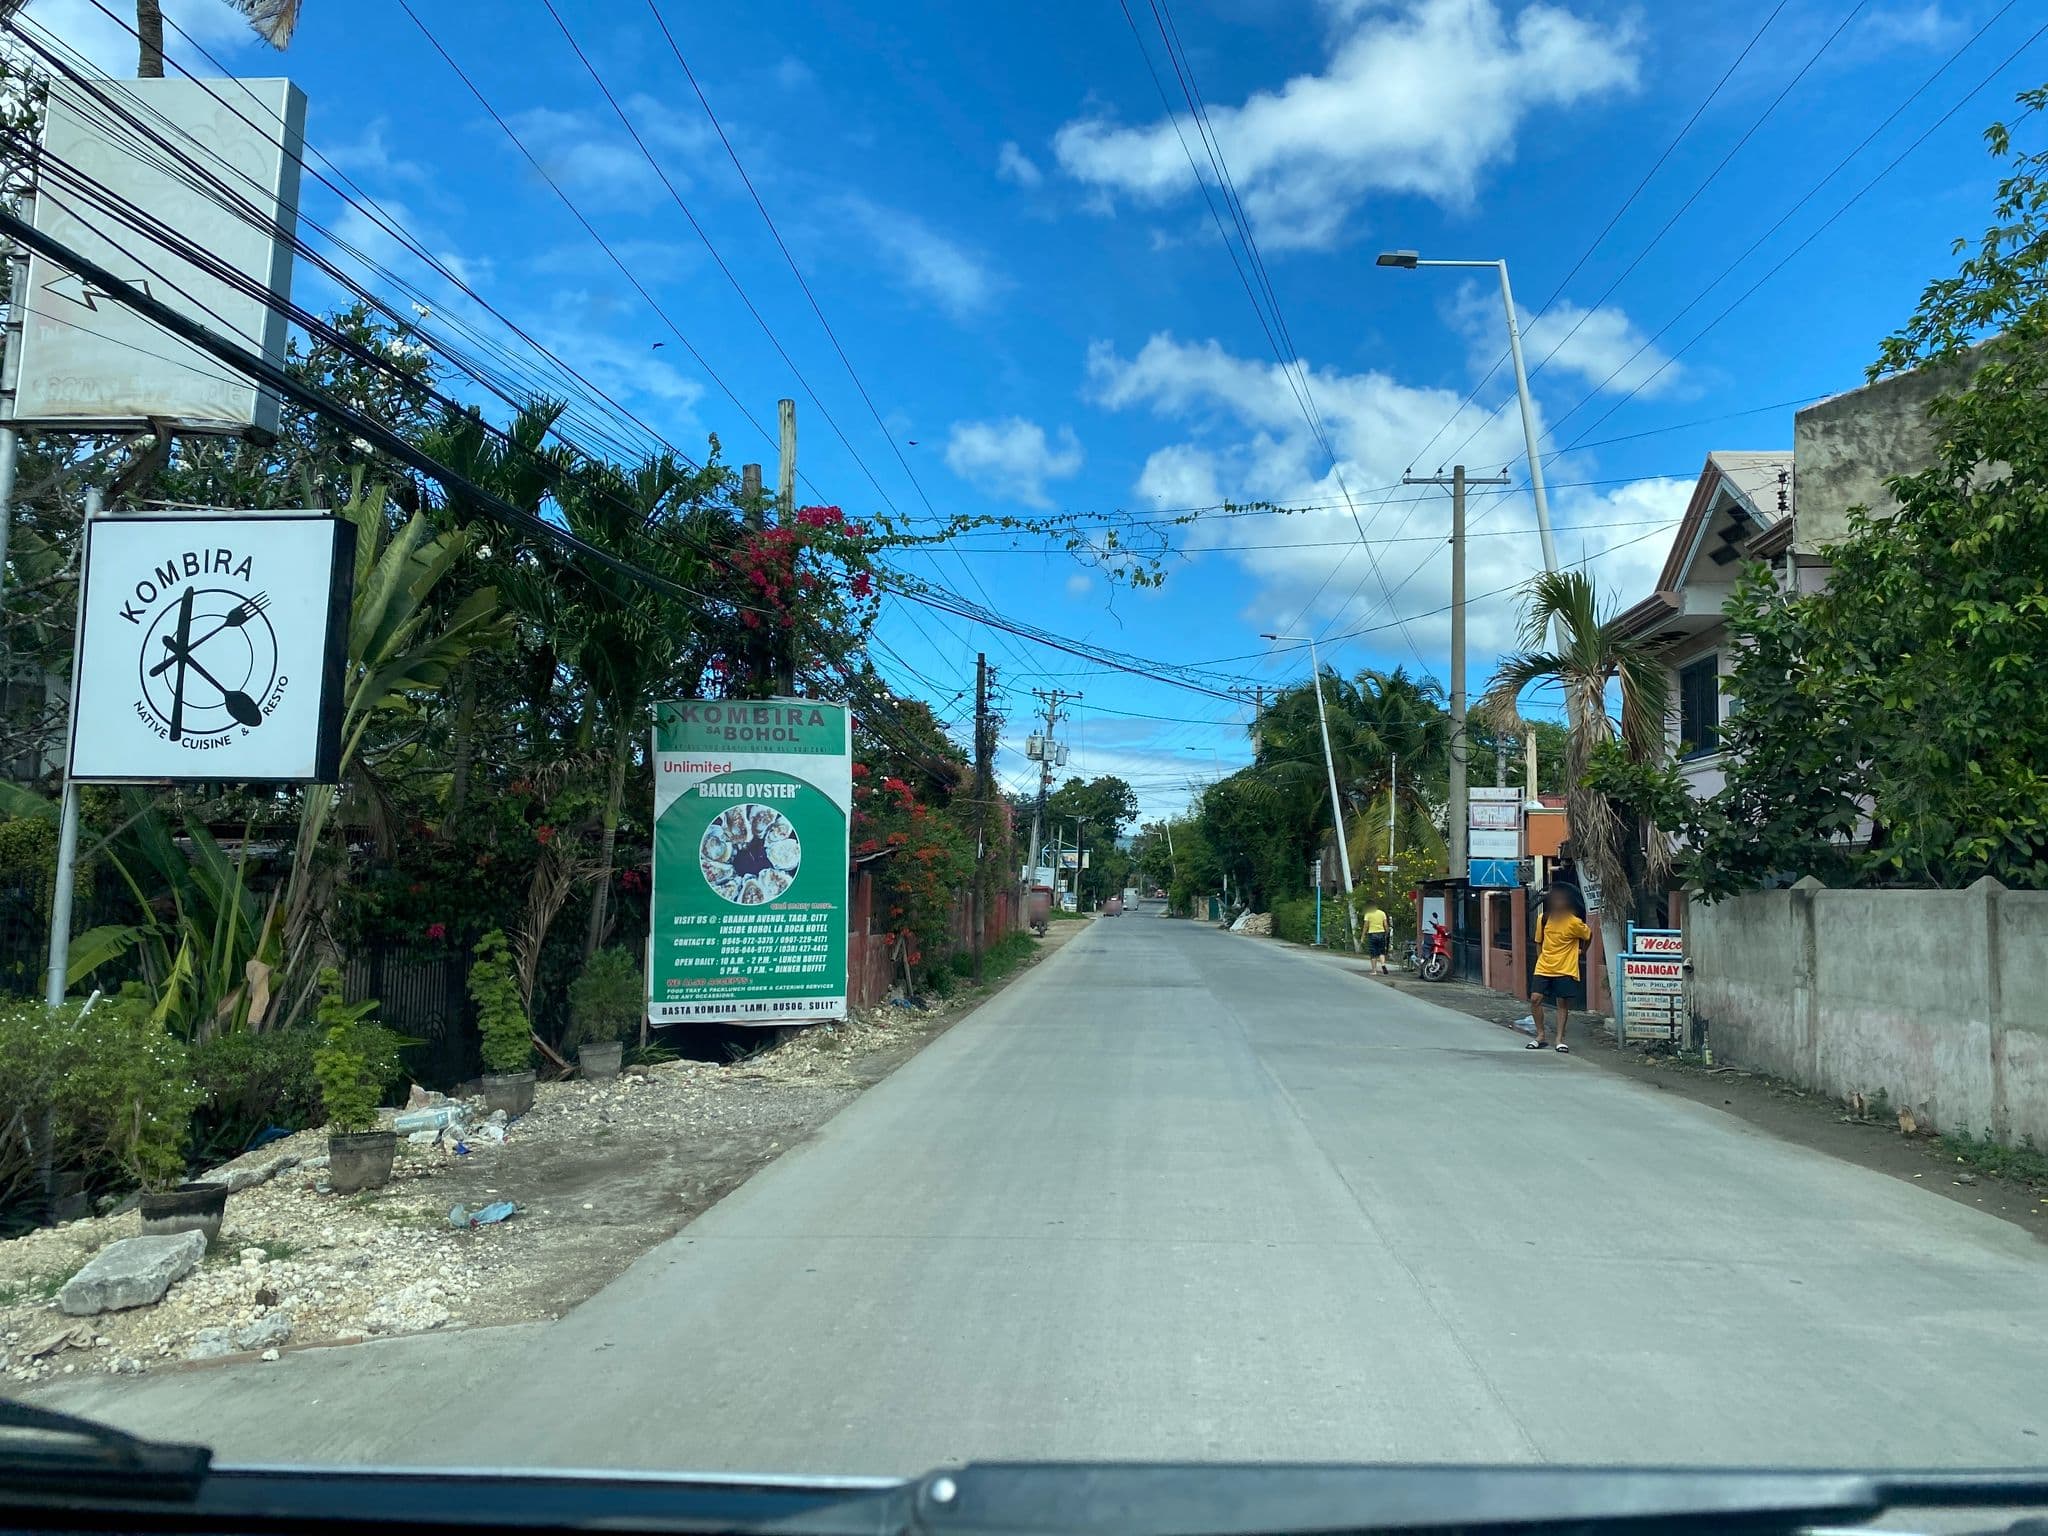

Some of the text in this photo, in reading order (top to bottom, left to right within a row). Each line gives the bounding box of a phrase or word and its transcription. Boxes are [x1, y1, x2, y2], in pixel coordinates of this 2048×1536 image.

[119, 548, 253, 624] KOMBIRA
[133, 676, 289, 750] NATIVE CUISINE & RESTO
[681, 705, 825, 726] KOMBIRA
[724, 727, 800, 742] BOHOL
[664, 761, 731, 773] Unlimited
[674, 916, 695, 925] VISIT
[697, 915, 708, 924] US
[722, 915, 755, 923] GRAHAM
[811, 914, 828, 922] CITY
[720, 926, 746, 934] INSIDE
[747, 925, 772, 933] BOHOL
[773, 925, 783, 933] LA
[806, 924, 828, 932] HOTEL
[674, 938, 705, 946] CONTACT
[1641, 938, 1682, 950] Welco
[674, 958, 694, 966] OPEN
[694, 958, 715, 966] DAILY
[779, 955, 802, 963] LUNCH
[775, 965, 800, 973] DINNER
[802, 964, 827, 972] BUFFET
[1627, 964, 1680, 975] BARANGAY
[662, 1007, 691, 1015] BASTA
[695, 1005, 736, 1014] KOMBIRA
